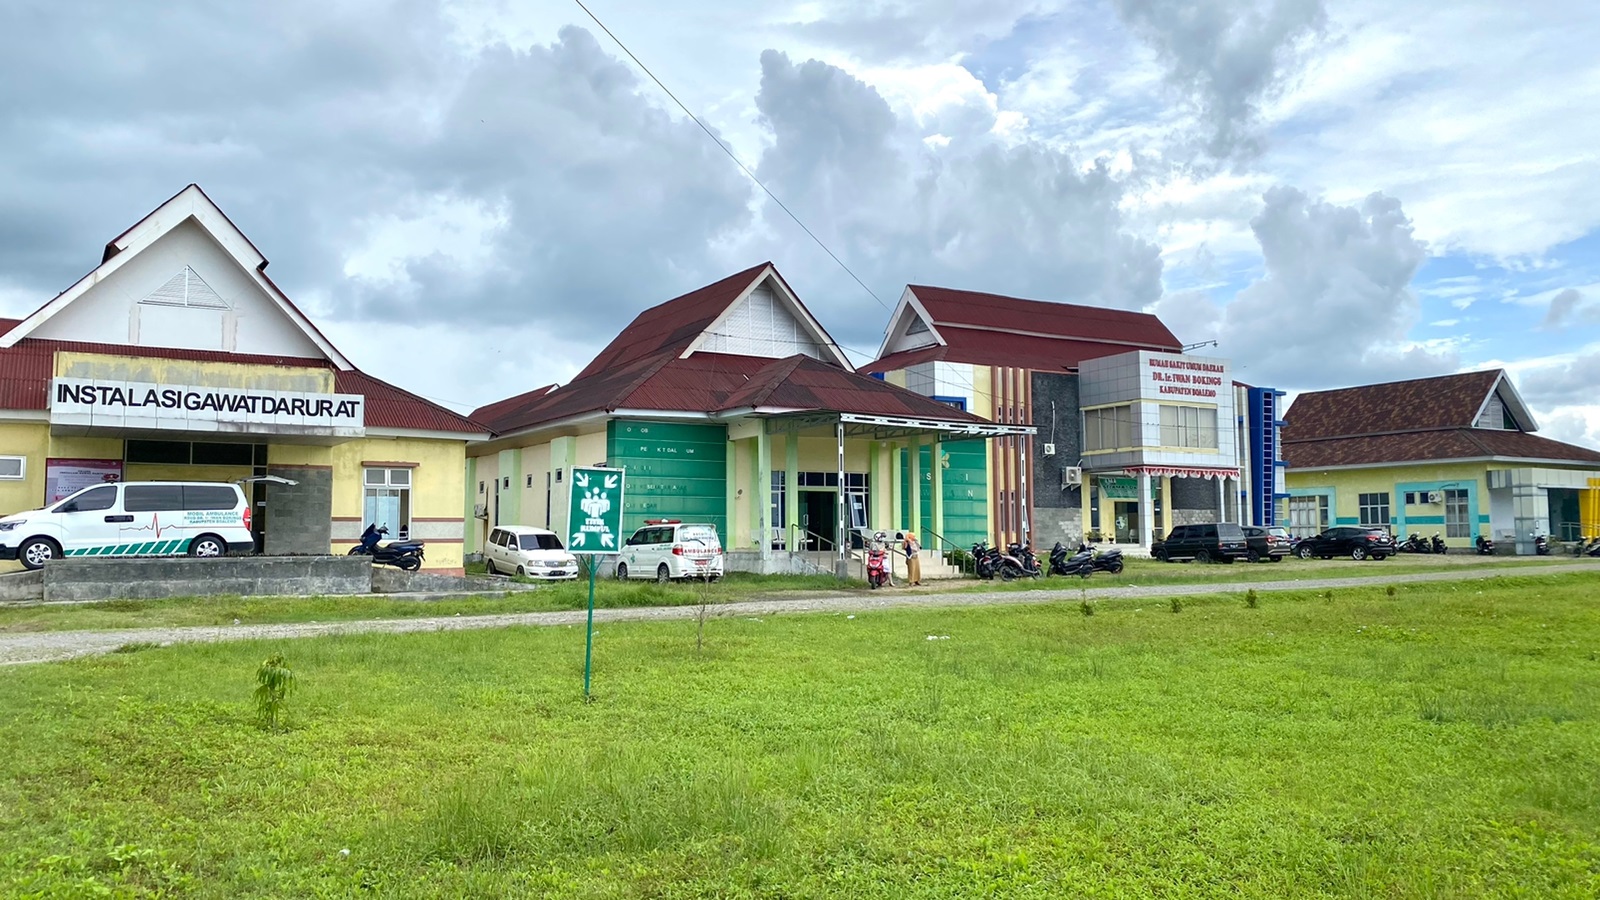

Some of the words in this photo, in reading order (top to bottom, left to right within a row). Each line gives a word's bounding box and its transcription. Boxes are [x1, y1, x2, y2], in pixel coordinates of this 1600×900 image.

[1172, 373, 1191, 384] IWAN
[1192, 375, 1222, 386] BOKINGS
[1159, 385, 1191, 396] KABUPATEN
